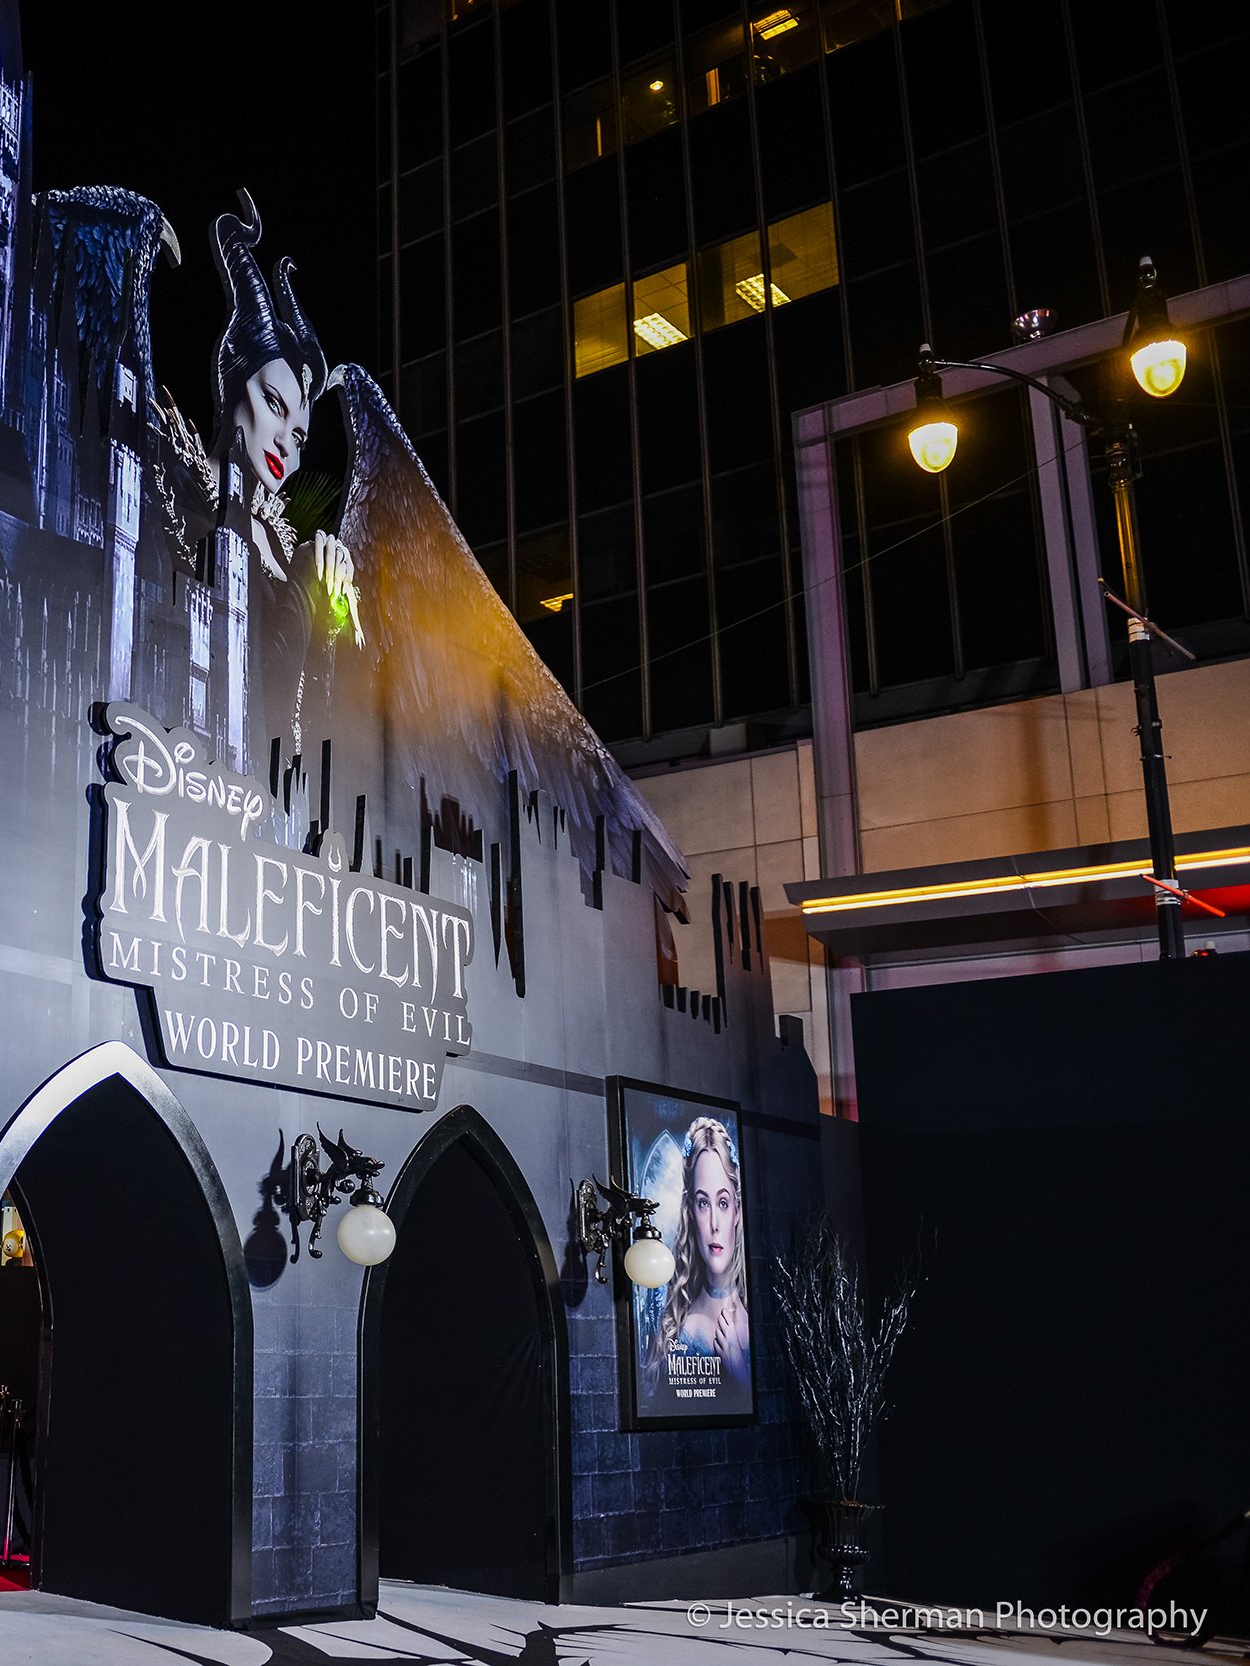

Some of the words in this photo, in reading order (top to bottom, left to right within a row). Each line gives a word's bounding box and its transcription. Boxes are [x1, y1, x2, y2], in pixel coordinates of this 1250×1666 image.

[108, 797, 472, 1005] MALEFICENT
[109, 932, 315, 1010] MISTRESS
[339, 987, 380, 1023] OF
[401, 1003, 471, 1046] EVIL
[165, 1010, 280, 1069] WORLD
[297, 1036, 437, 1101] PREMIERE
[668, 1353, 721, 1376] MALEFICENT
[668, 1377, 697, 1385] MISTRESS
[698, 1377, 707, 1385] OF
[708, 1377, 722, 1385] EVIL
[675, 1389, 693, 1398] WORLD
[693, 1389, 716, 1398] PREMIERE
